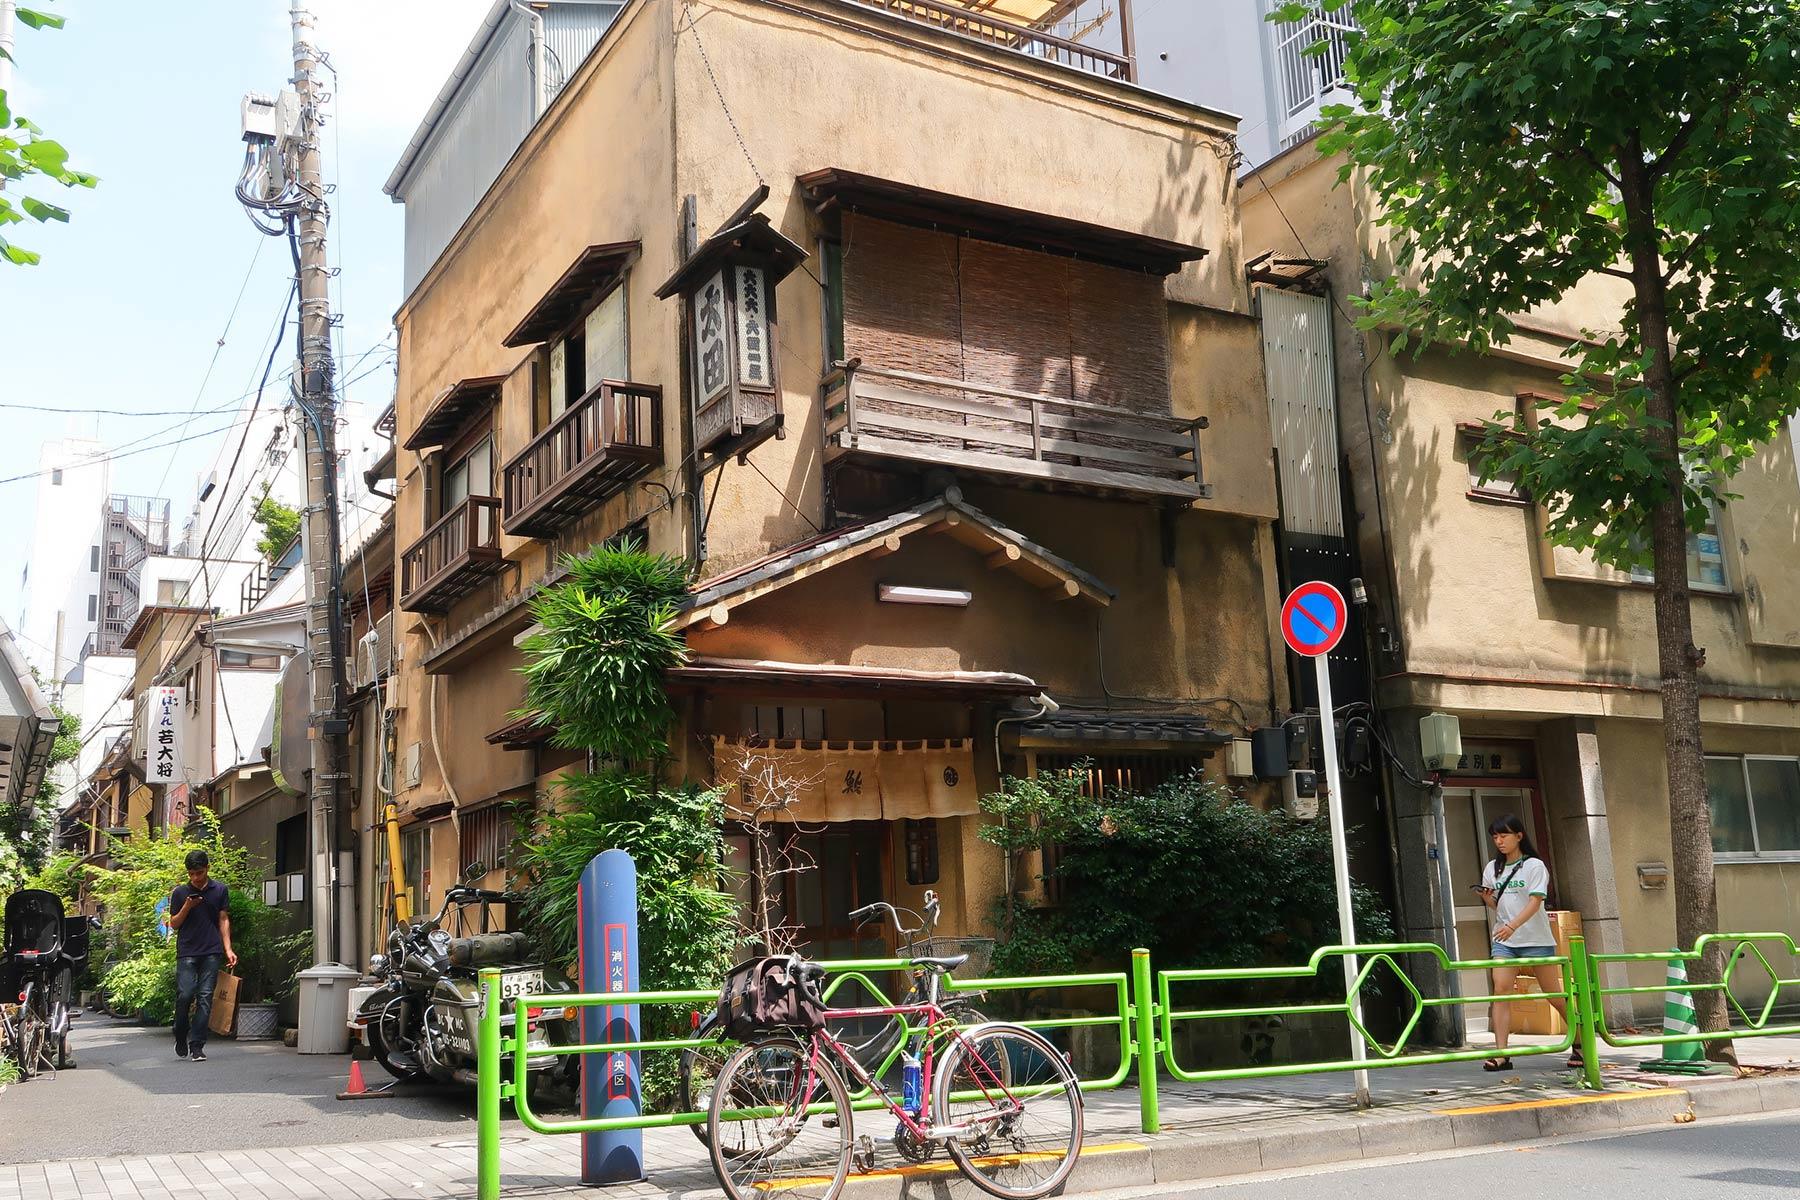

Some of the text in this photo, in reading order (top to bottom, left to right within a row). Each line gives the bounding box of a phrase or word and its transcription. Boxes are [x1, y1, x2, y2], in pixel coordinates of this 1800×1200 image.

[700, 284, 724, 394] 太田
[157, 729, 174, 777] 若大将
[504, 980, 543, 998] 93-54
[611, 950, 624, 992] 消火器
